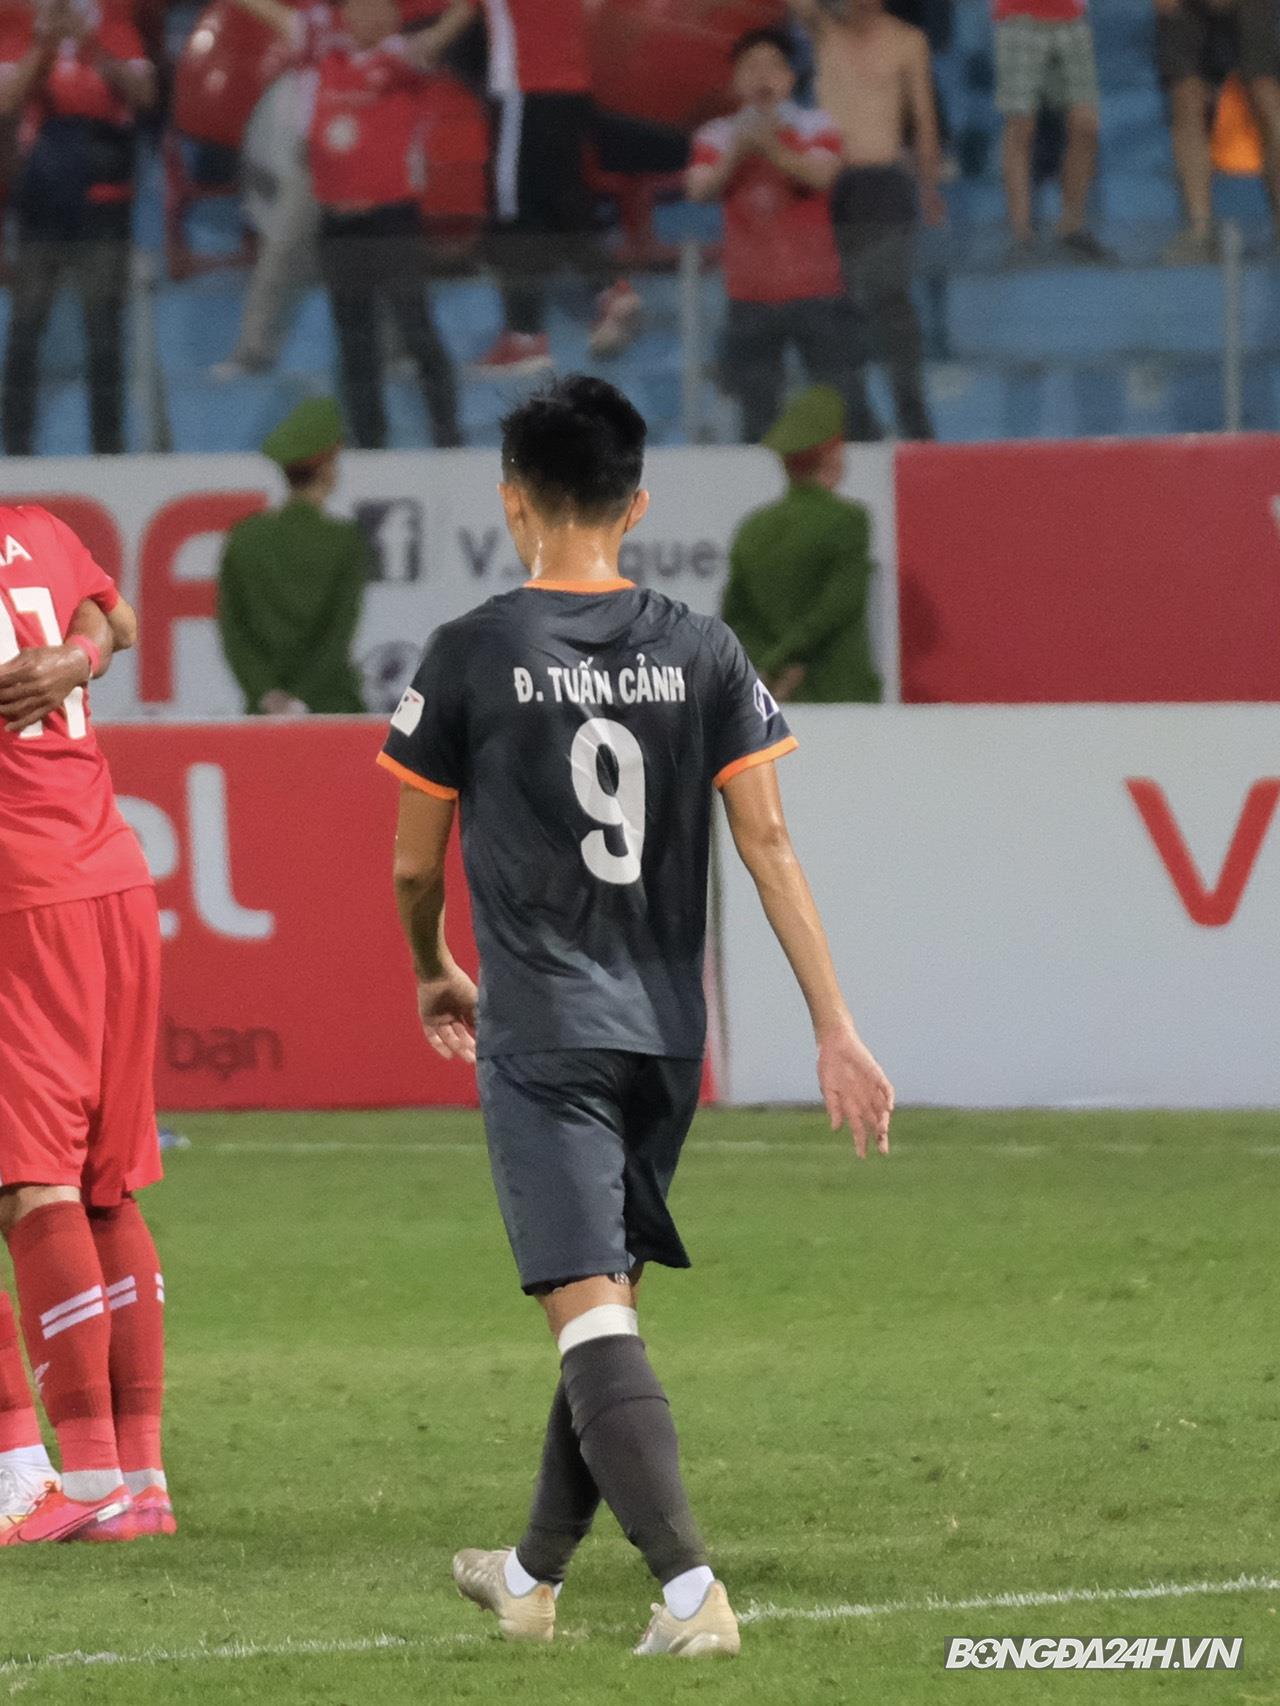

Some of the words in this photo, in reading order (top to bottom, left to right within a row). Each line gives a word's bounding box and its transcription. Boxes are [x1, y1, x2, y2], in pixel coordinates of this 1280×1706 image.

[513, 667, 544, 702] Đ.
[547, 656, 613, 704] TUẤN
[619, 652, 686, 703] CẢNH
[571, 718, 646, 885] 9
